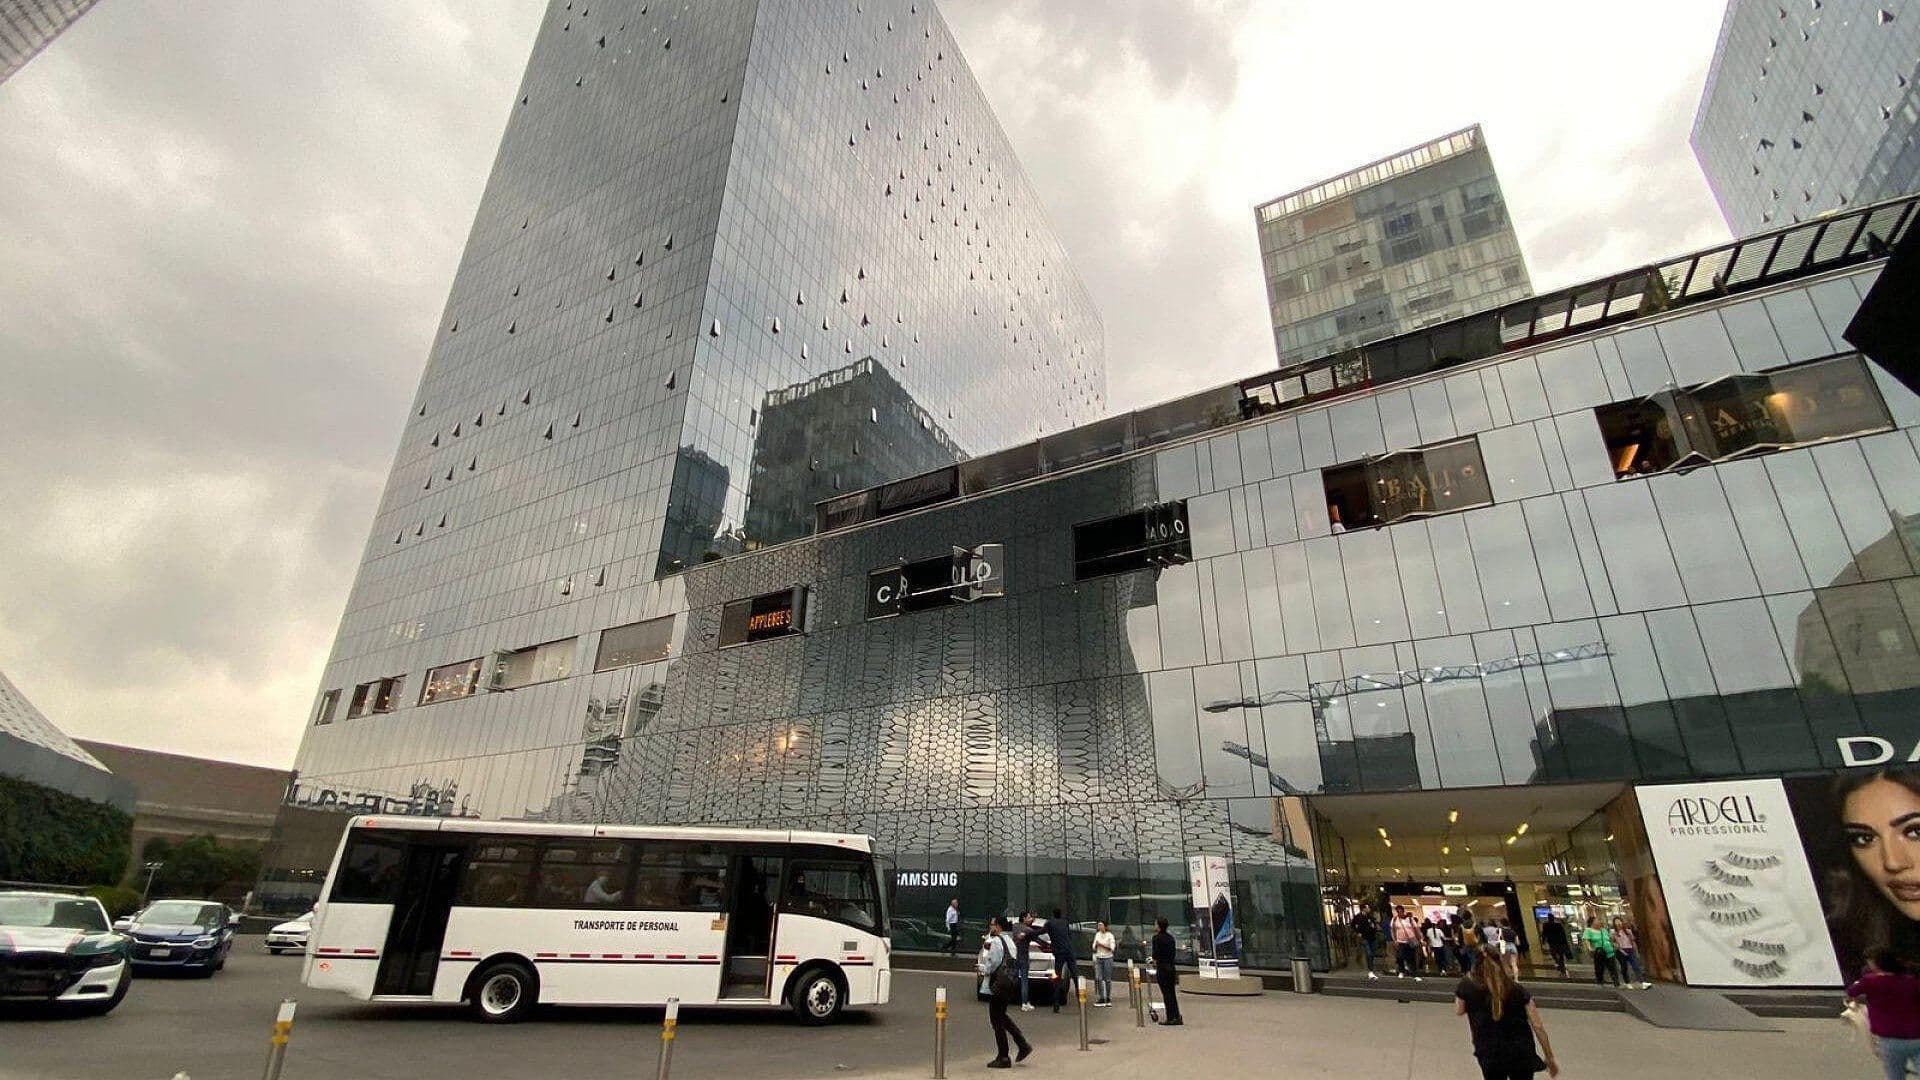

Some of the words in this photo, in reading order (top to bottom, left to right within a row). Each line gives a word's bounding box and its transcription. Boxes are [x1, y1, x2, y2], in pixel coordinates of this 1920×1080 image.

[1668, 795, 1765, 826] ARDELL
[1670, 825, 1767, 836] PROFESSIONAL
[574, 920, 624, 931] TRANSPORTE
[626, 921, 637, 931] DE
[639, 922, 679, 932] PERSONAL
